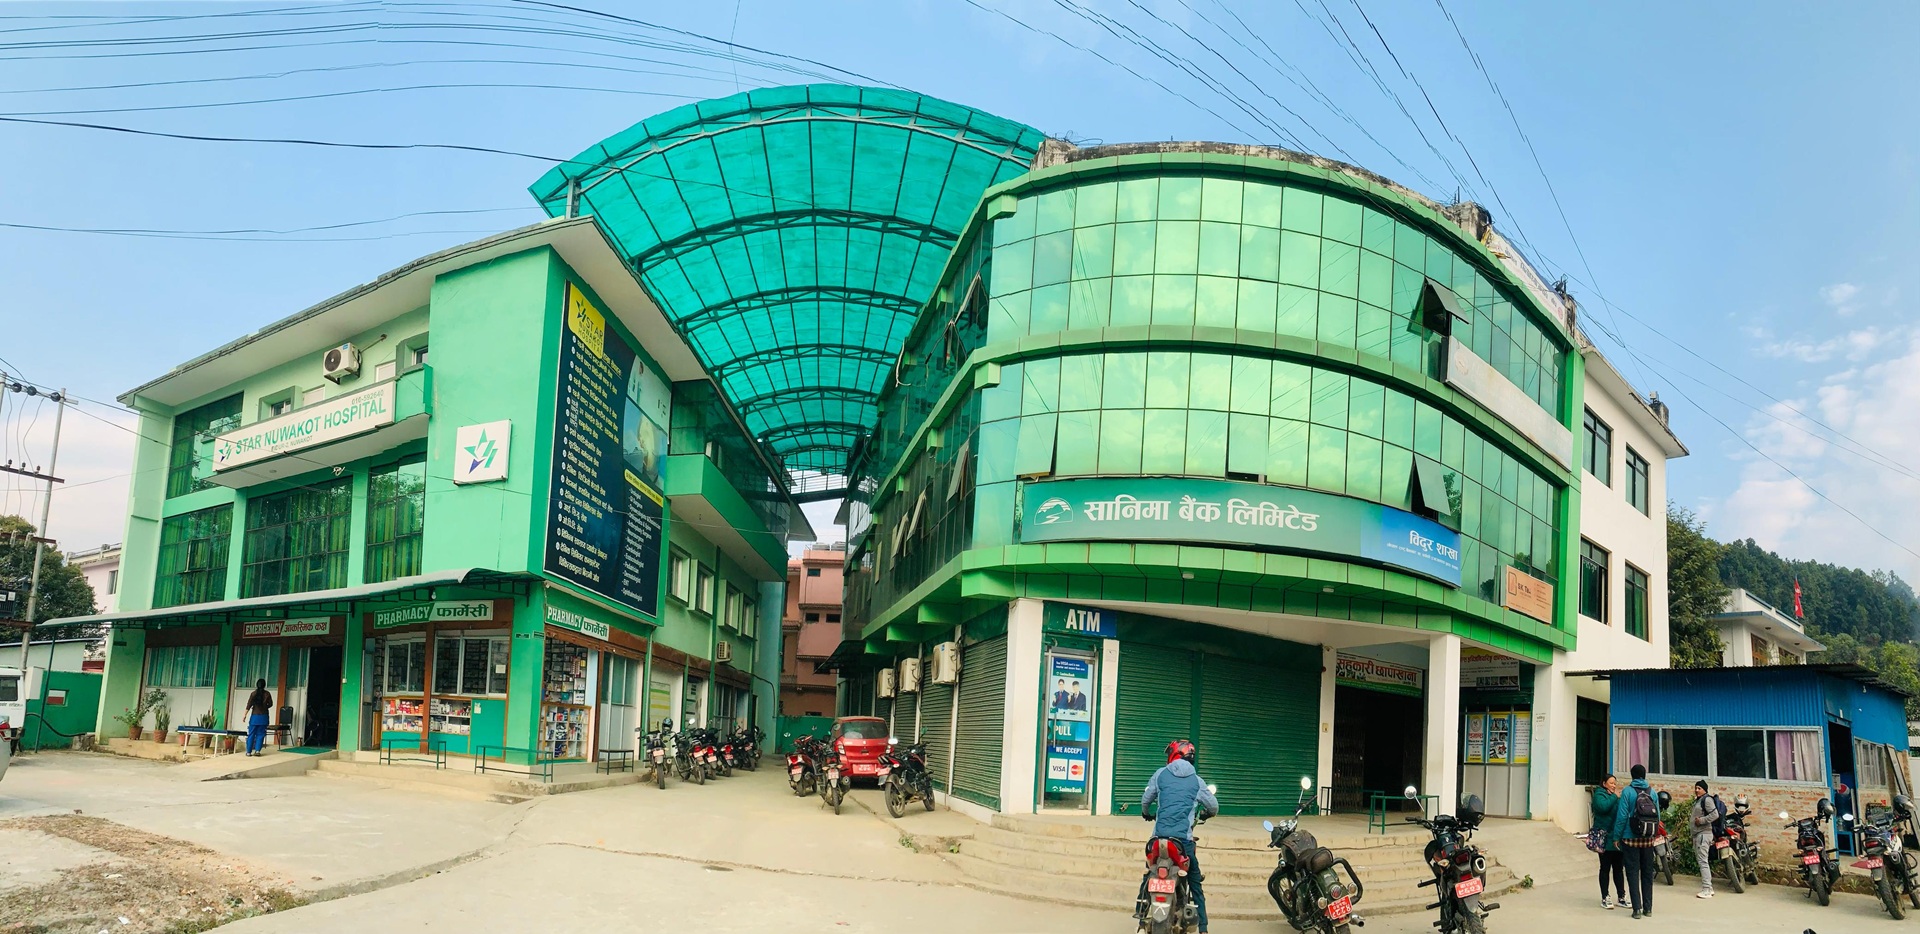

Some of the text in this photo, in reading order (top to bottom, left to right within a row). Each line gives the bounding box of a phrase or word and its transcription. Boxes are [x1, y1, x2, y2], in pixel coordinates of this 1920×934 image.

[235, 397, 387, 455] STAR NUWAKOT HOSPITAL
[1084, 494, 1320, 532] सानिमा बैंक लिमिटेड
[1409, 530, 1434, 552] विदुर
[1436, 542, 1459, 561] शाखा
[377, 606, 431, 625] PHARMACY
[436, 603, 489, 617] फार्मेसी
[547, 606, 582, 628] PHARMACY
[245, 622, 283, 635] EMERGENCY
[284, 621, 327, 632] आकस्मिक कक्ष
[583, 621, 608, 637] फार्मेसी
[1065, 608, 1100, 633] ATM
[1337, 658, 1374, 674] सहकारी
[1376, 665, 1417, 682] छापाखाना
[1054, 725, 1072, 736] PULL
